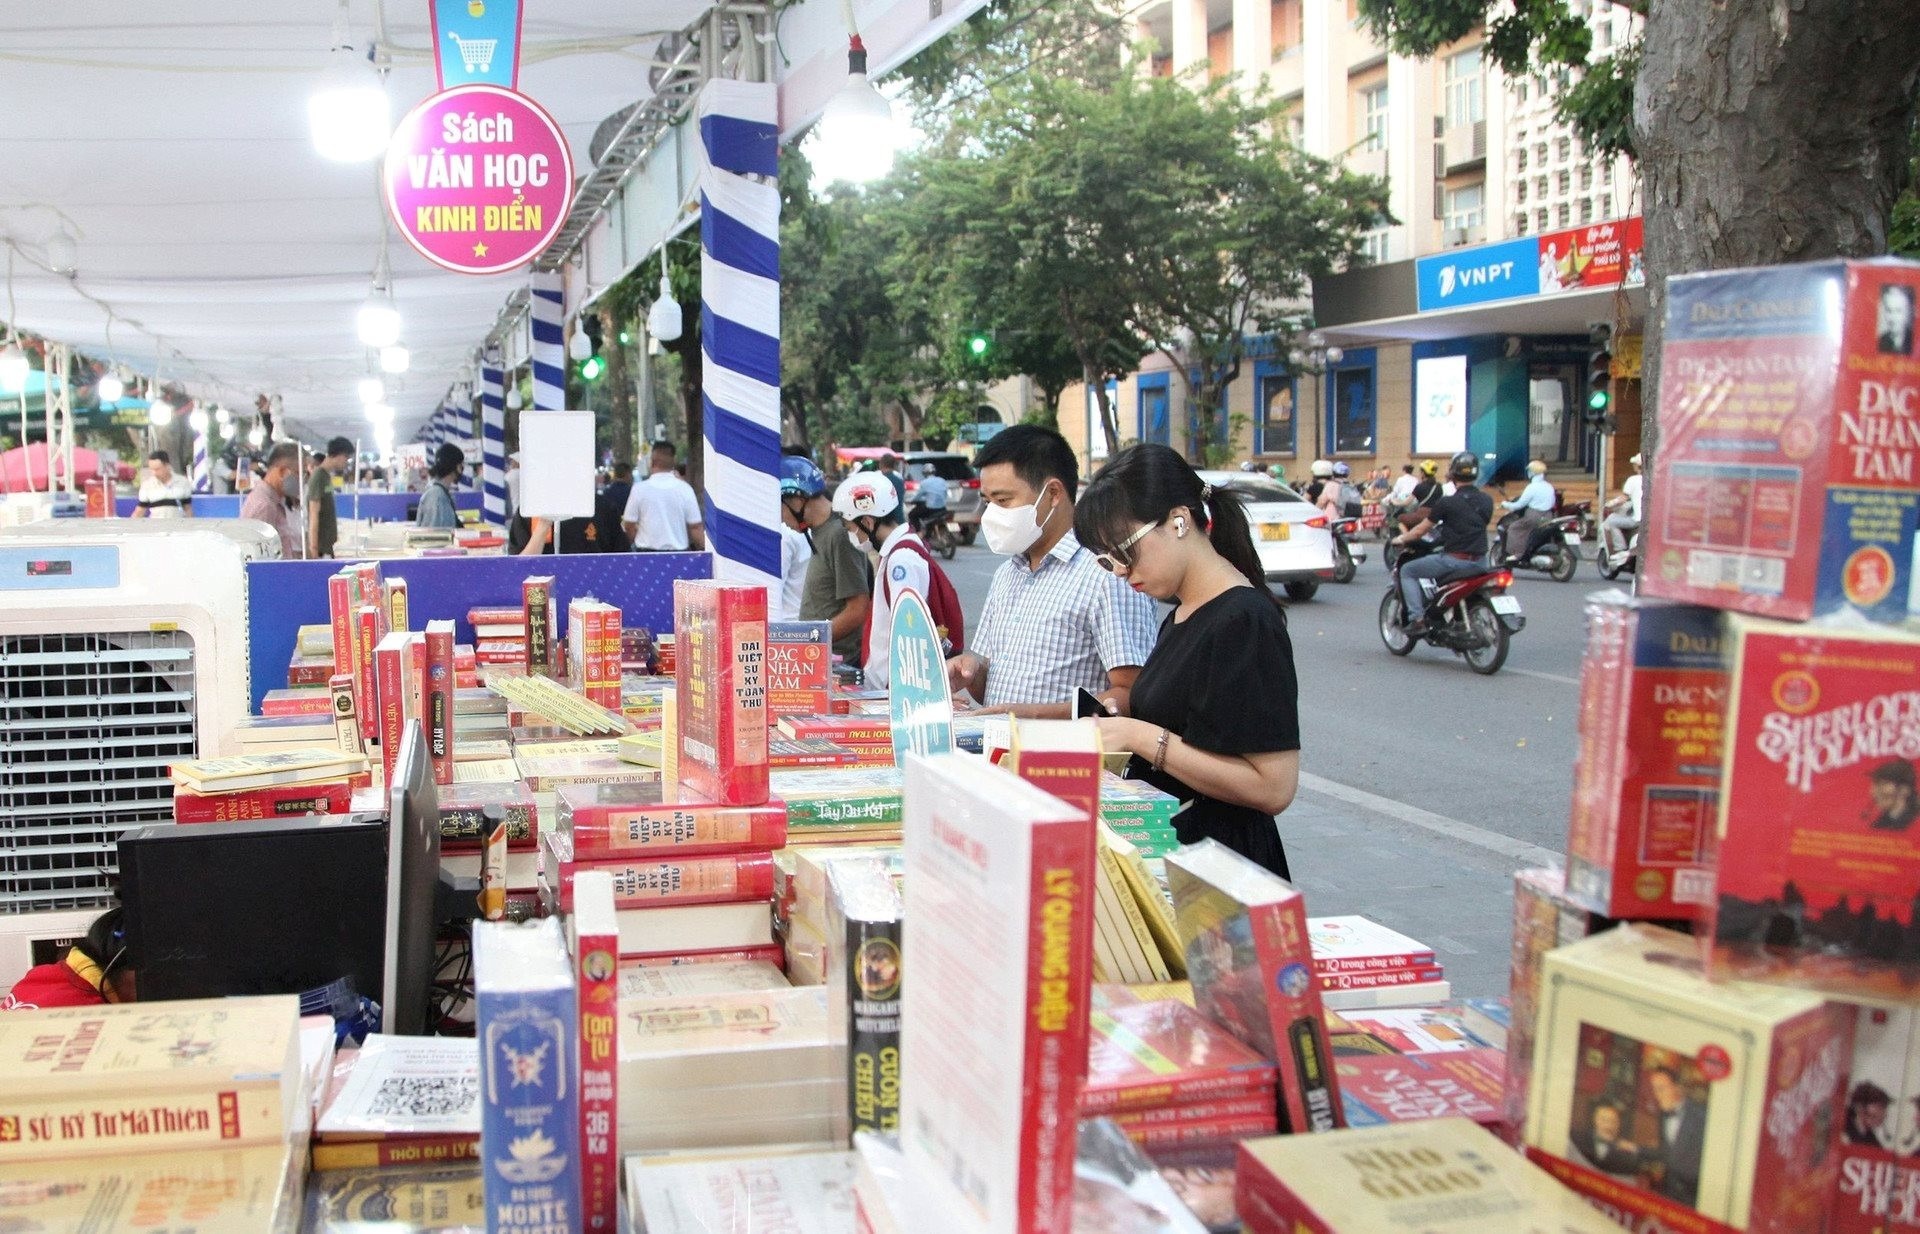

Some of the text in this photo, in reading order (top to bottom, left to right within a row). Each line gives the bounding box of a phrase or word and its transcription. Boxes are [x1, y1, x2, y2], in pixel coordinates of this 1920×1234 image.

[442, 112, 513, 143] Sách
[407, 147, 549, 194] VĂN HỌC
[417, 195, 541, 233] KINH ĐIỂN
[1459, 262, 1514, 288] VNPT
[897, 633, 931, 691] SALE
[433, 728, 444, 739] HY
[1341, 959, 1365, 970] trong
[1366, 957, 1387, 968] công
[1390, 956, 1407, 966] việc
[1353, 976, 1376, 986] trong
[1378, 973, 1397, 984] công
[1399, 972, 1416, 982] việc
[586, 1111, 609, 1136] 36
[497, 1201, 568, 1224] MONTE
